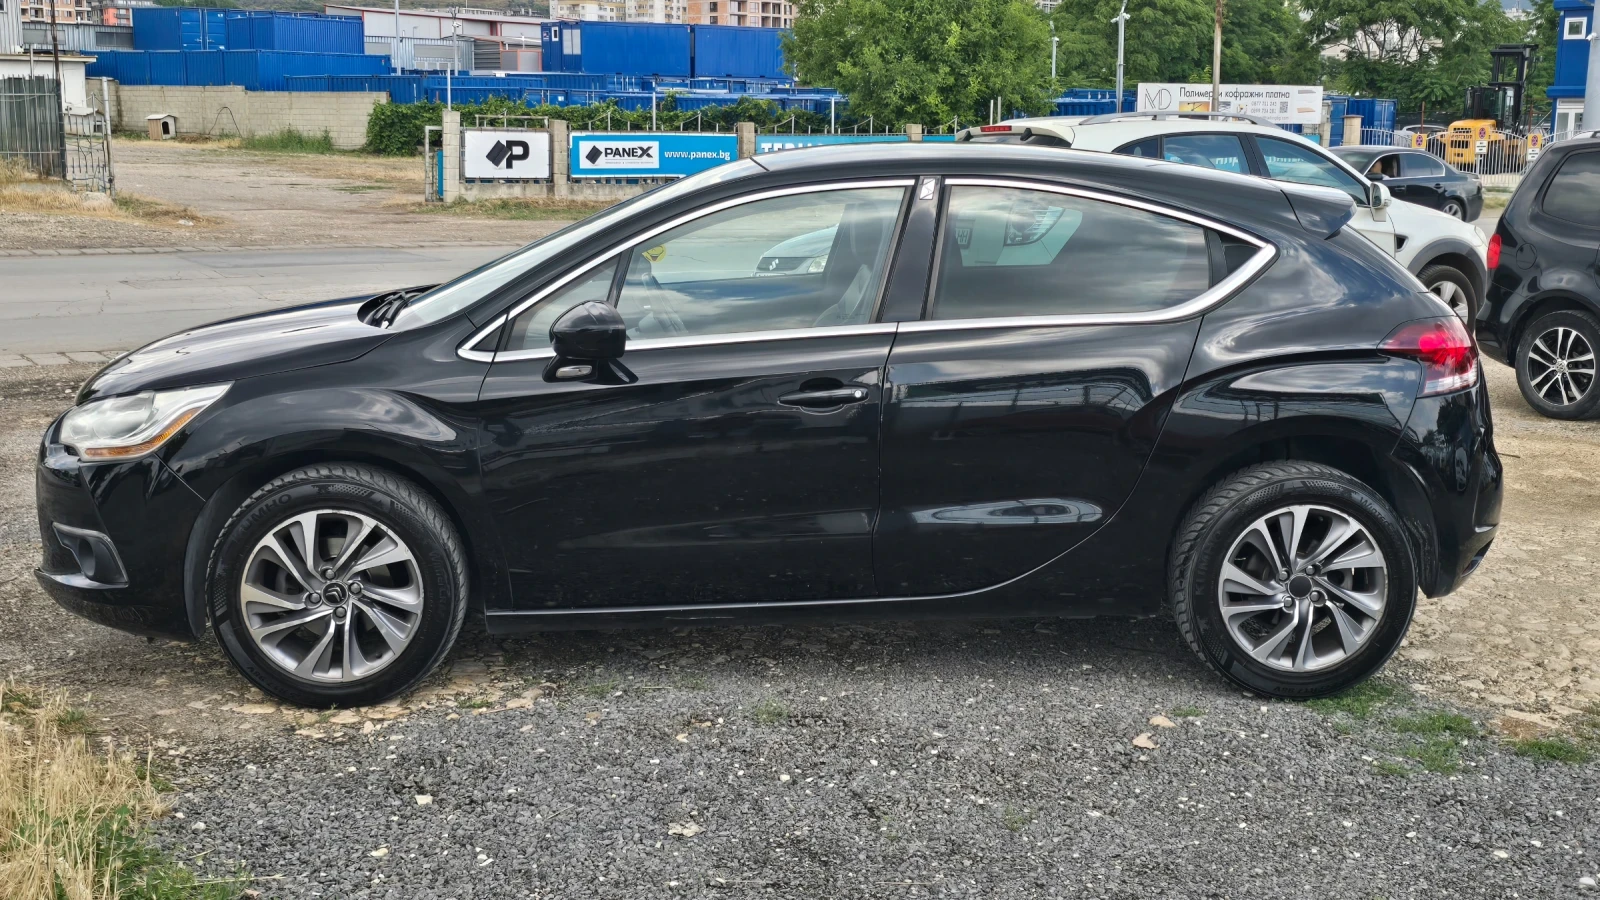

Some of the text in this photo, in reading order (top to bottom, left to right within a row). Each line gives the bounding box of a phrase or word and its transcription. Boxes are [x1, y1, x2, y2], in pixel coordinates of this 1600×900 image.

[1180, 87, 1222, 100] Полимери
[1225, 88, 1263, 100] кофражни
[506, 140, 530, 169] P
[604, 146, 653, 158] PANEX
[664, 150, 731, 160] www.panex.bg
